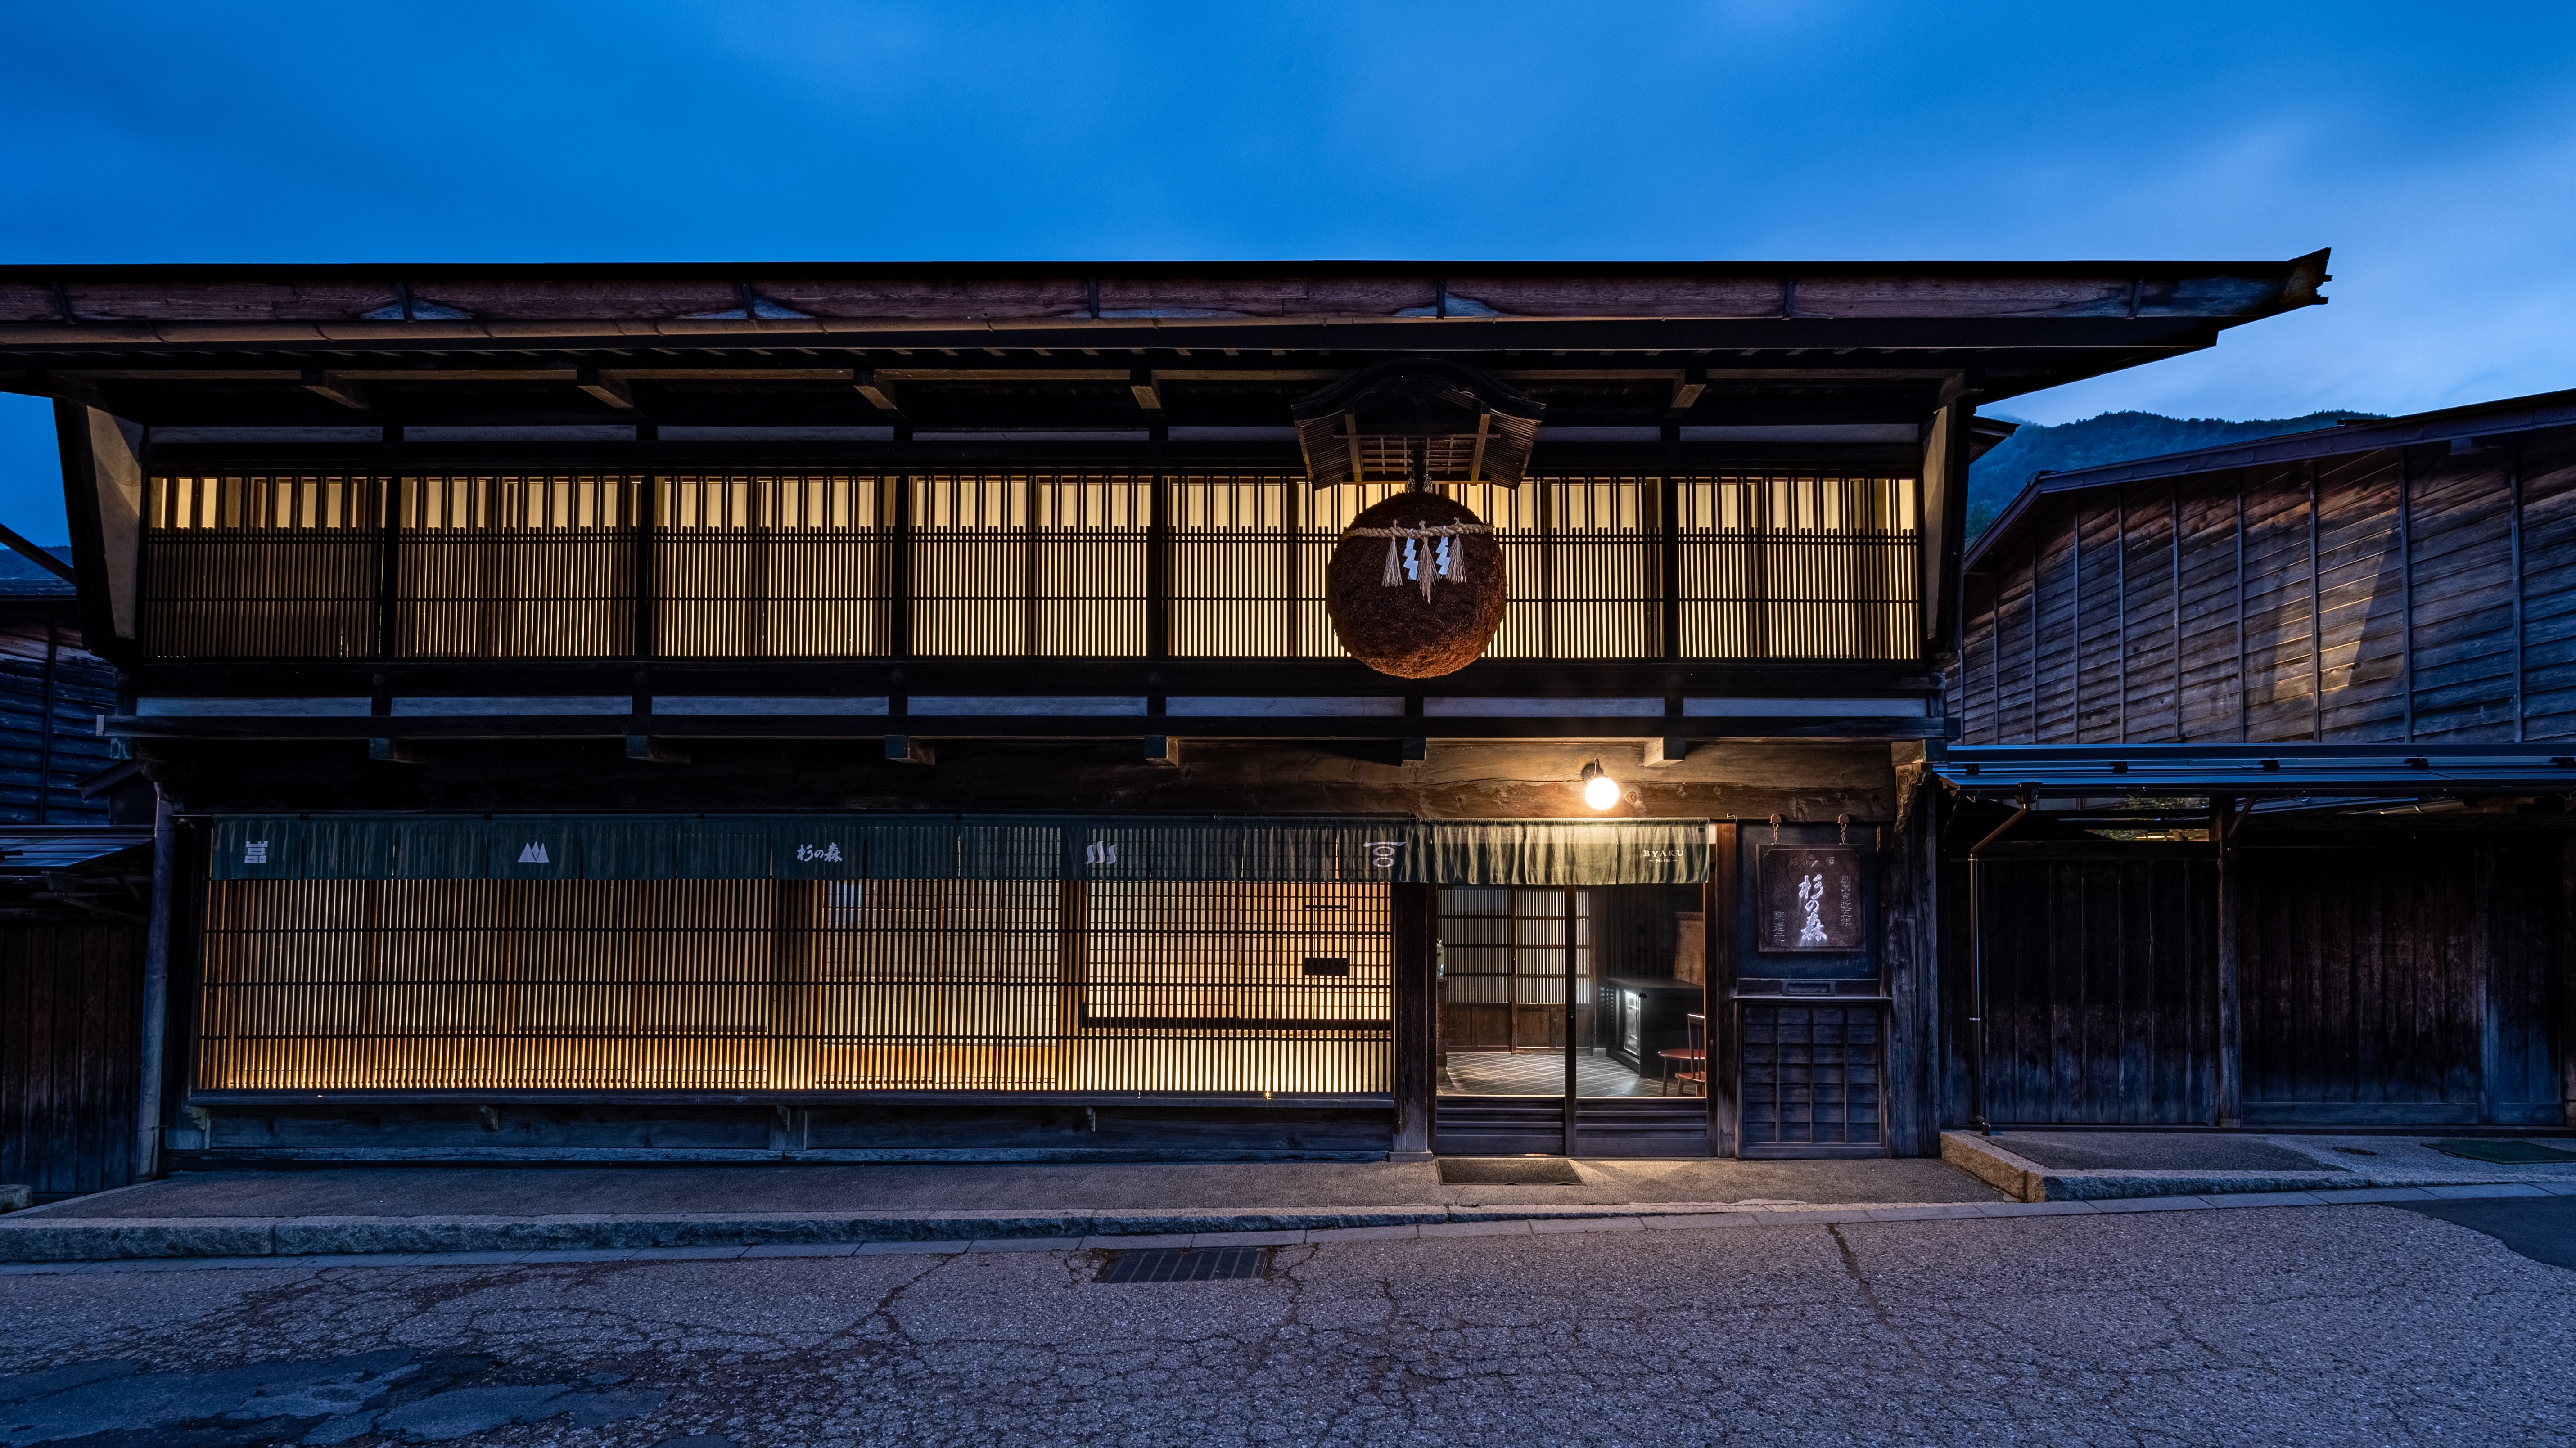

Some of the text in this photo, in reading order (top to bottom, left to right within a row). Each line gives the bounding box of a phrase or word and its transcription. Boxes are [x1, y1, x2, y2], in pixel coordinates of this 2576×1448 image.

[797, 842, 843, 863] 杉の森
[1798, 874, 1828, 942] 杉の森
